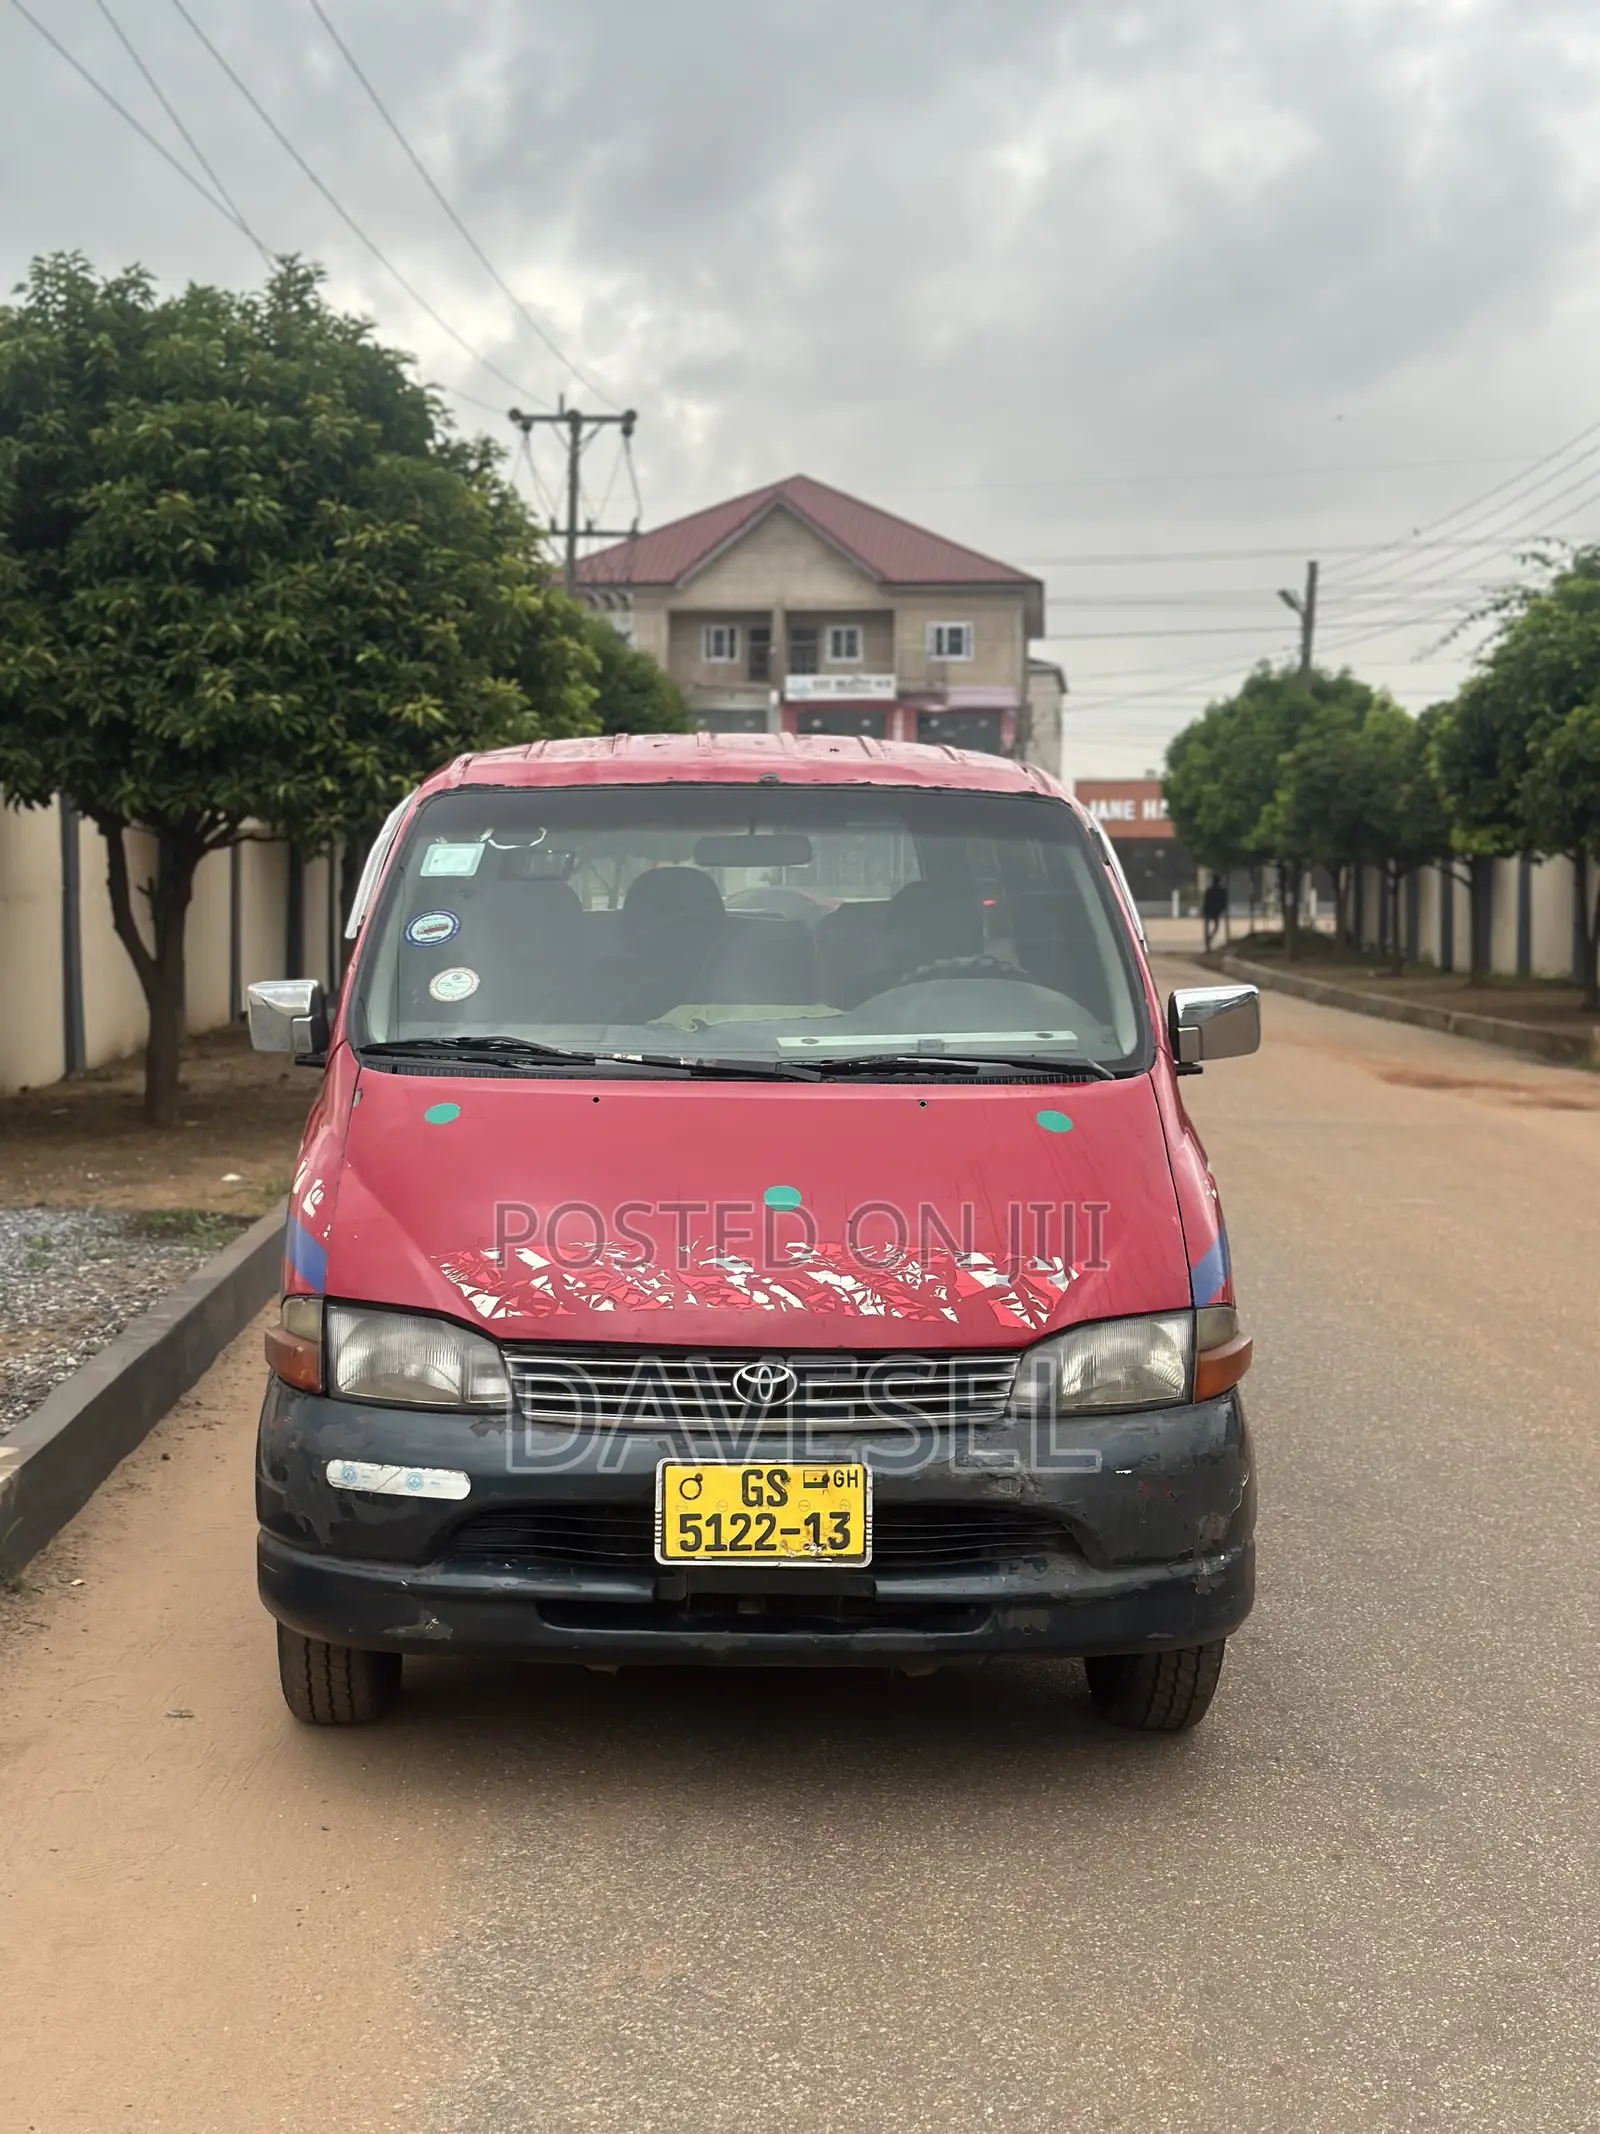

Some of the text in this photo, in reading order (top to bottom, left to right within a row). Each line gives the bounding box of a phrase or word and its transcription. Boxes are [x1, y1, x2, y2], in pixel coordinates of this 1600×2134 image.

[741, 1469, 858, 1507] GS GH
[679, 1512, 850, 1551] 5122-13
